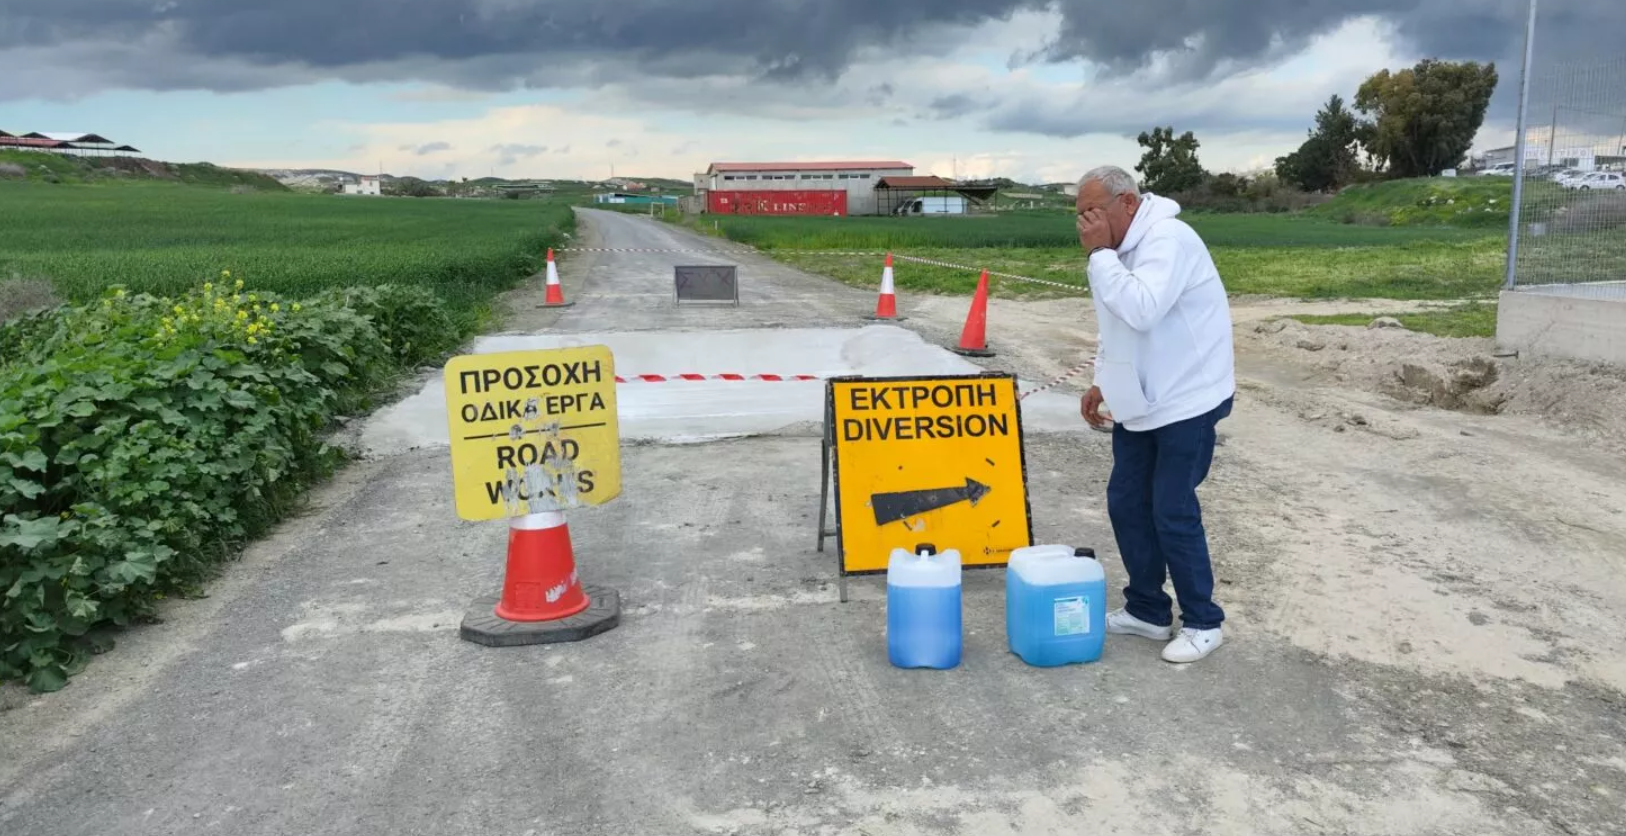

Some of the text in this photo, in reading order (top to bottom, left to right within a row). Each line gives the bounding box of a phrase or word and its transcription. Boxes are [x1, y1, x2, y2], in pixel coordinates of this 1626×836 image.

[460, 360, 602, 394] ΠΡΟΣΟΧΗ
[546, 392, 606, 415] ΕΡΓΑ
[850, 383, 997, 411] ΕΚΤΡΟΠΗ
[843, 413, 1009, 442] DIVERSION
[497, 438, 580, 469] ROAD
